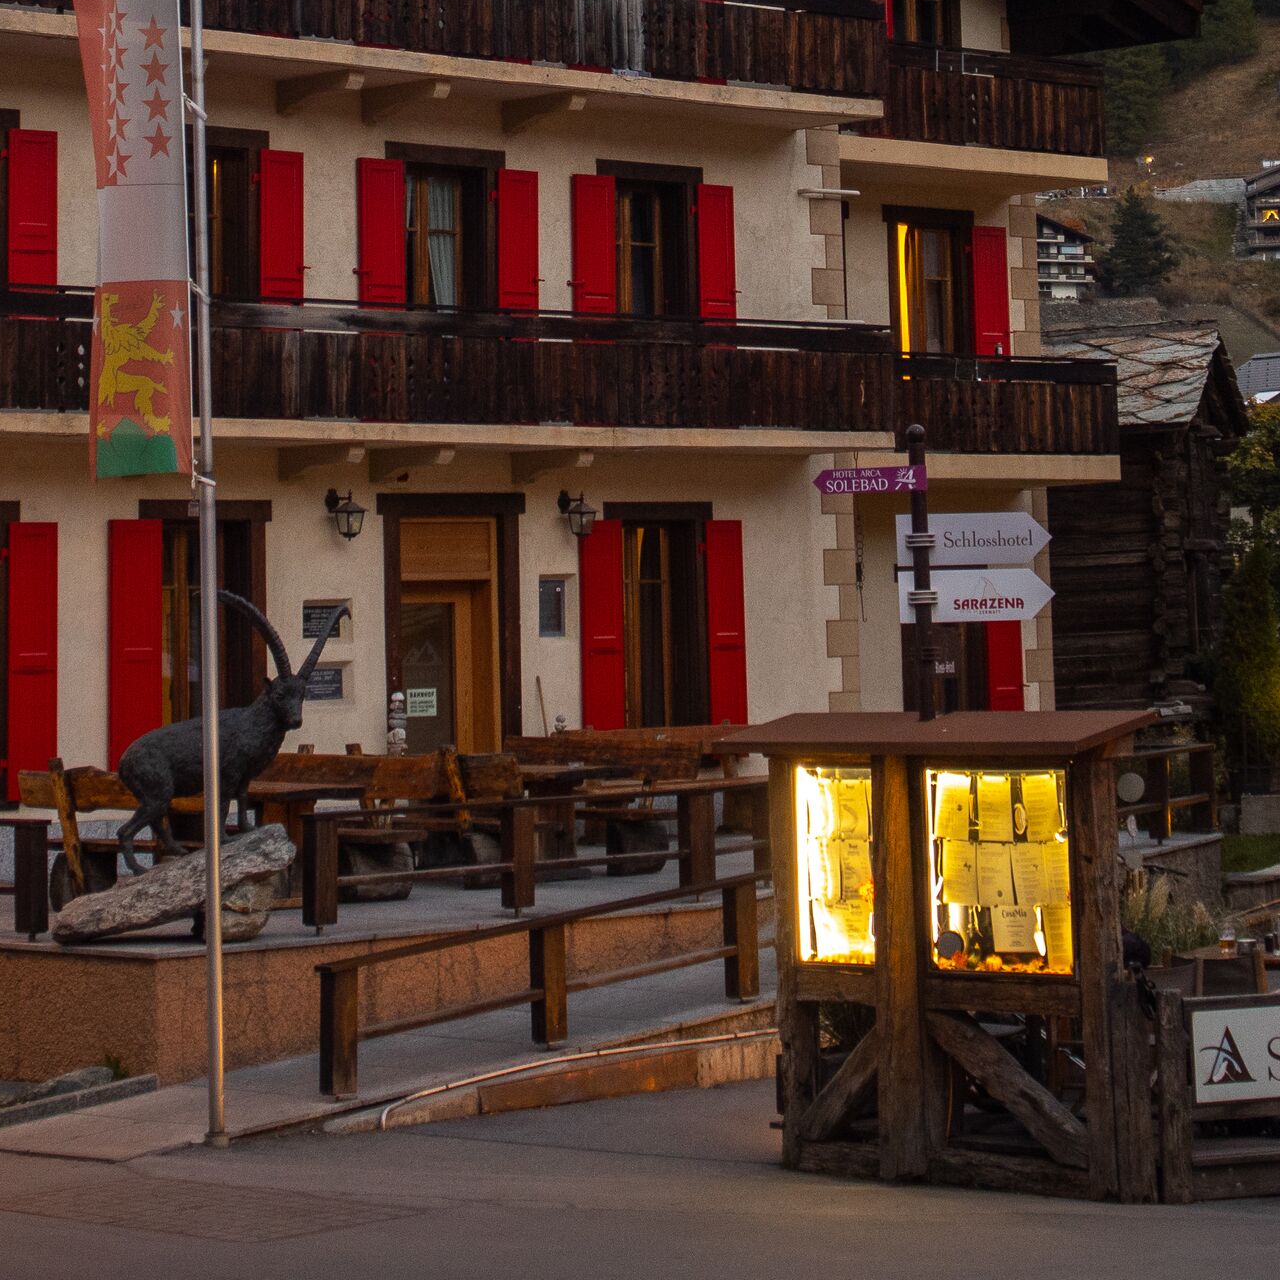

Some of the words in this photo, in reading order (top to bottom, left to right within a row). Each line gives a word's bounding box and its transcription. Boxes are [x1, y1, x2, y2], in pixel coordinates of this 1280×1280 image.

[832, 470, 858, 479] HOTEL
[860, 469, 883, 478] ARCA
[825, 478, 890, 493] SOLEBAD
[943, 528, 1033, 549] Schlosshotel
[953, 597, 1024, 611] SARAZENA
